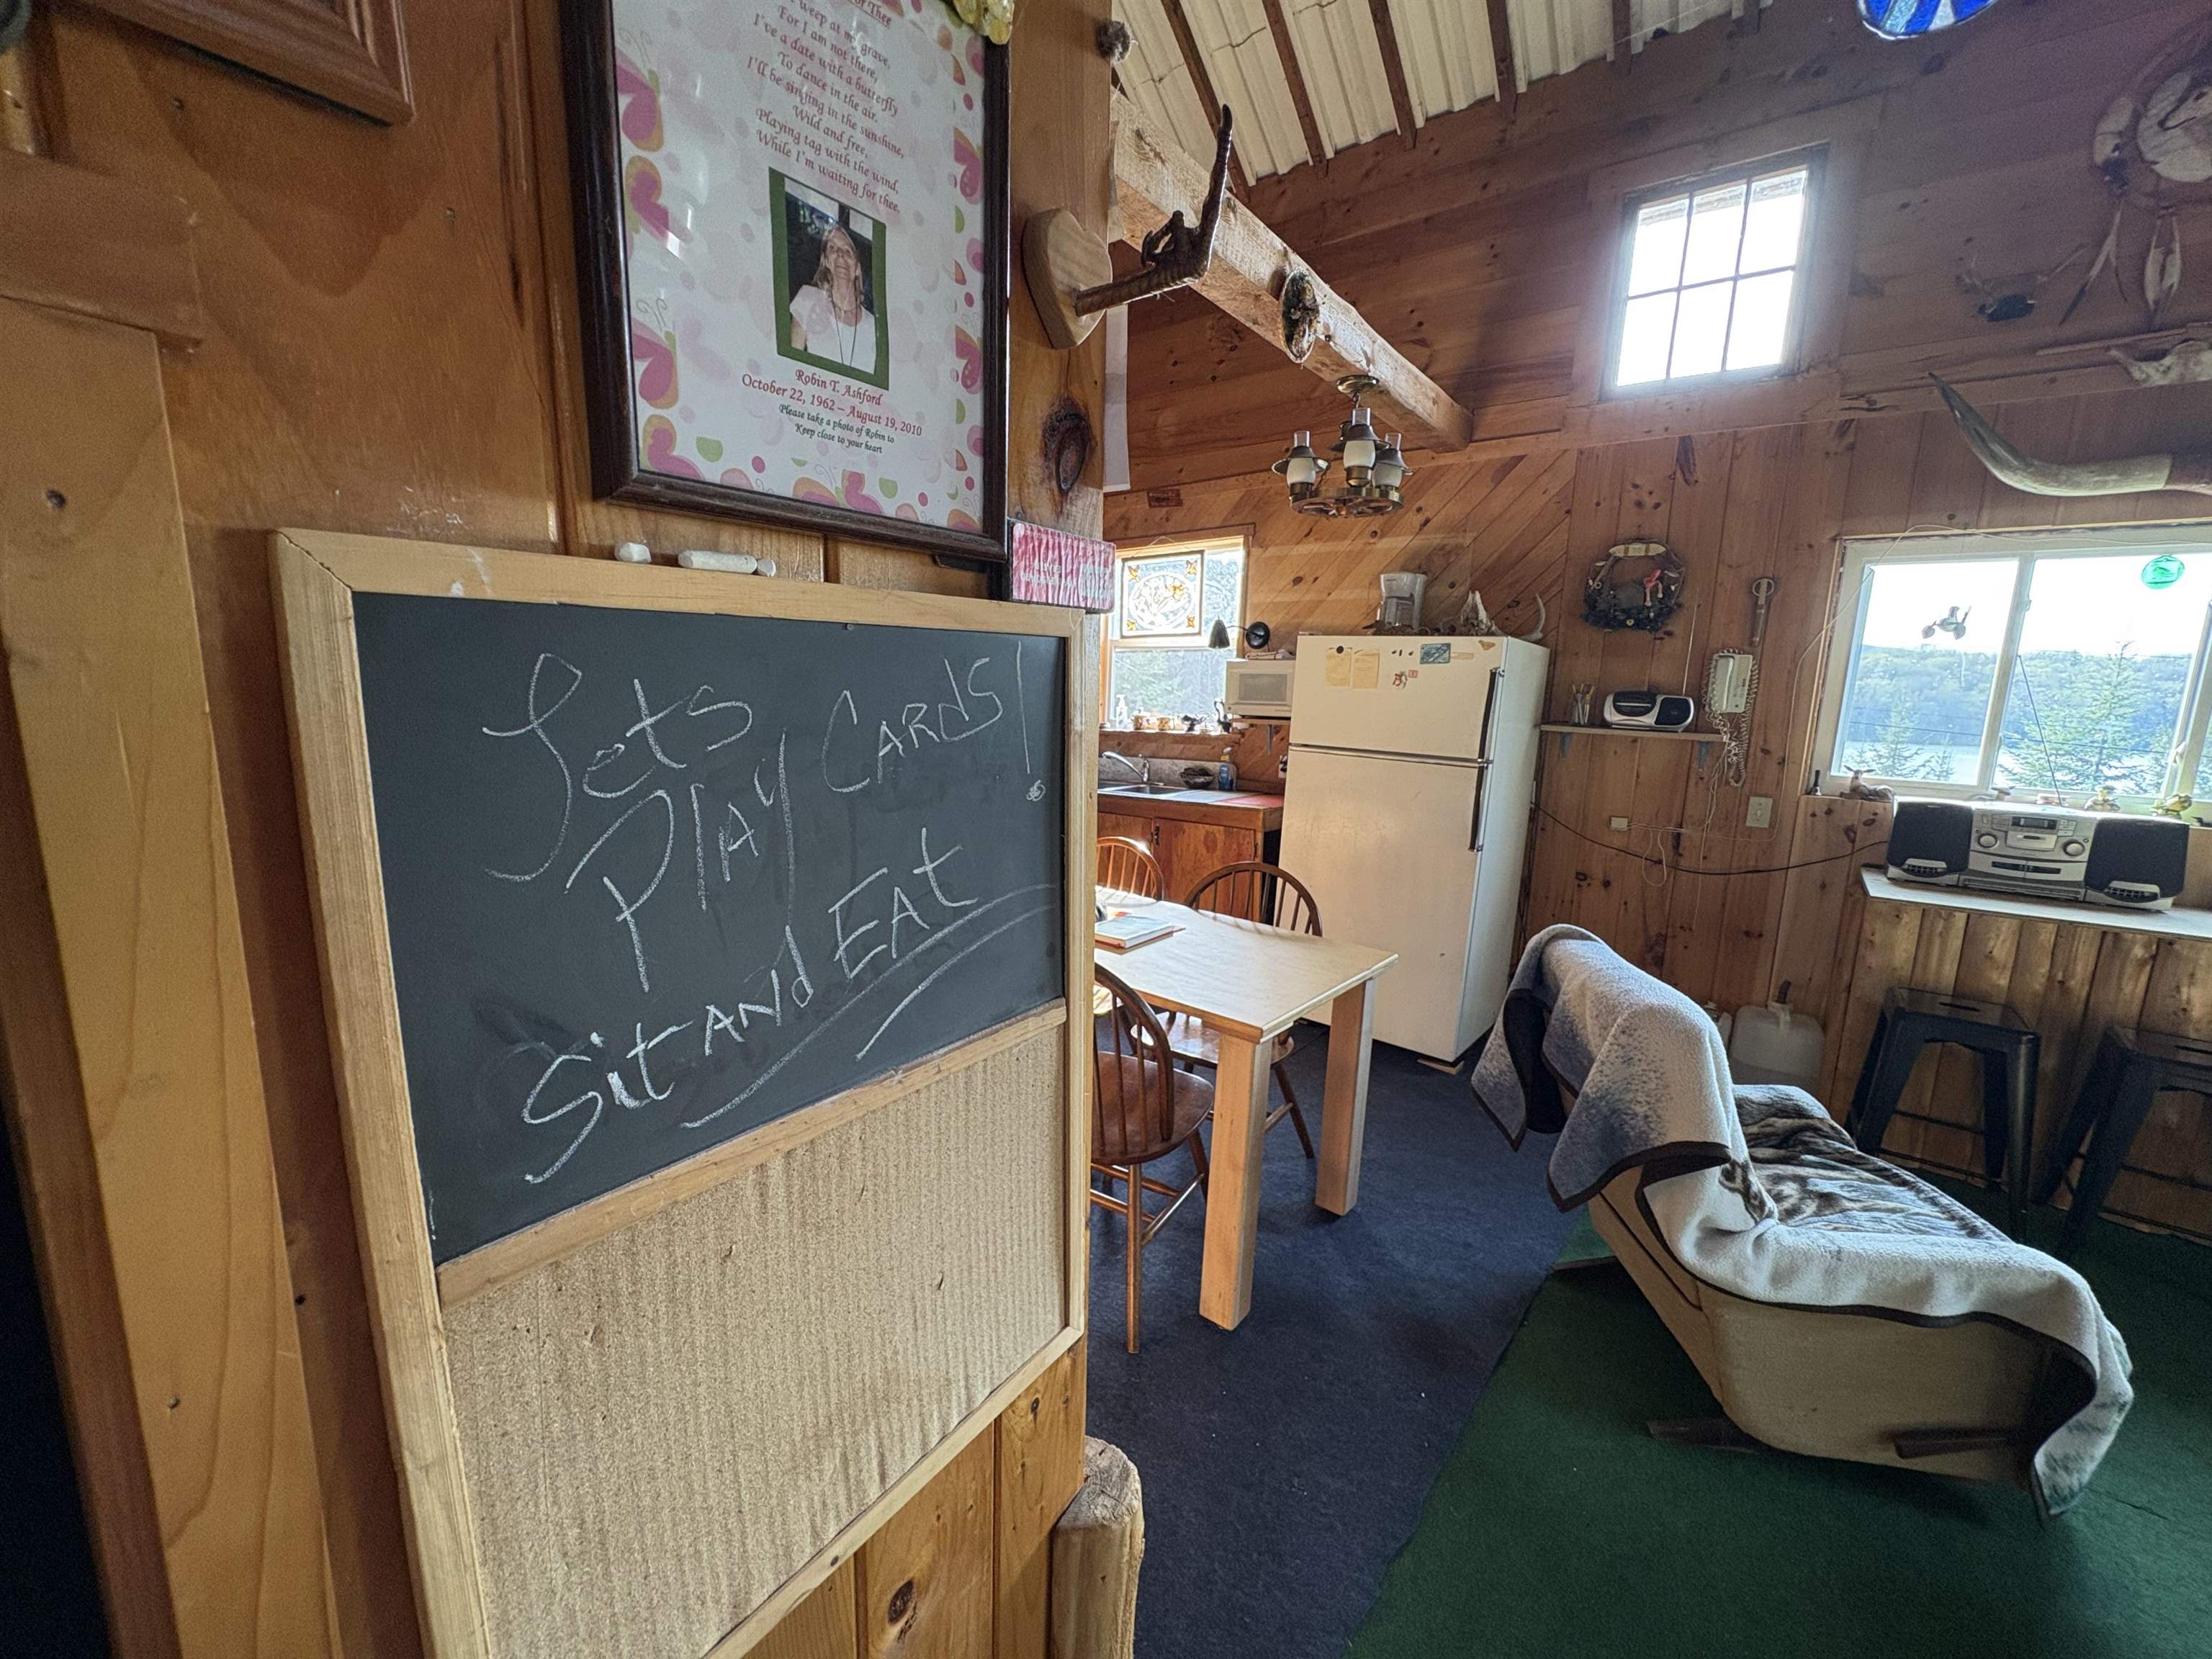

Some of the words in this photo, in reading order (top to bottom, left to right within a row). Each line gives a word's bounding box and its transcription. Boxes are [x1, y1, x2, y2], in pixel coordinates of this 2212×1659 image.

[778, 5, 800, 28] For
[802, 21, 808, 35] I
[811, 31, 827, 48] am
[830, 42, 848, 60] not
[850, 55, 878, 84] there,
[799, 0, 827, 27] weep
[830, 22, 841, 35] at
[861, 43, 891, 69] grave,
[868, 1, 892, 26] Thee
[754, 14, 778, 38] I've
[781, 32, 788, 45] a
[791, 37, 815, 61] date
[819, 56, 844, 80] with
[846, 75, 853, 86] a
[855, 79, 899, 117] butterfly
[778, 51, 793, 71] To
[796, 65, 828, 91] dance
[830, 84, 841, 100] in
[843, 92, 860, 112] the
[862, 107, 878, 123] air.
[747, 55, 769, 76] I'll
[770, 69, 783, 86] be
[785, 80, 824, 115] singing
[829, 104, 839, 120] in
[841, 112, 858, 130] the
[860, 126, 904, 159] sunshine,
[793, 105, 824, 131] Wild
[824, 126, 846, 144] and
[845, 135, 869, 158] free,
[756, 108, 802, 145] Playing
[804, 135, 822, 156] tag
[826, 147, 851, 168] with
[853, 159, 870, 177] the
[872, 171, 899, 195] wind,
[756, 129, 793, 158] While
[796, 150, 815, 170] I'm
[818, 164, 859, 197] waiting
[858, 184, 878, 199] for
[878, 194, 900, 214] thee.
[742, 373, 788, 397] October
[789, 387, 806, 405] 22,
[809, 394, 836, 412] 1962
[846, 405, 883, 425] August
[885, 416, 898, 432] 19,
[899, 421, 923, 437] 2010
[795, 369, 827, 390] Robin
[829, 379, 840, 394] T.
[842, 385, 884, 407] Ashford
[778, 403, 806, 419] Please
[807, 412, 824, 427] take
[832, 421, 855, 433] photo
[855, 426, 866, 438] of
[865, 428, 886, 441] Robin
[887, 434, 895, 444] to
[794, 423, 816, 439] Keep
[817, 428, 835, 443] close
[837, 436, 845, 444] to
[845, 437, 864, 449] your
[864, 442, 884, 454] heart
